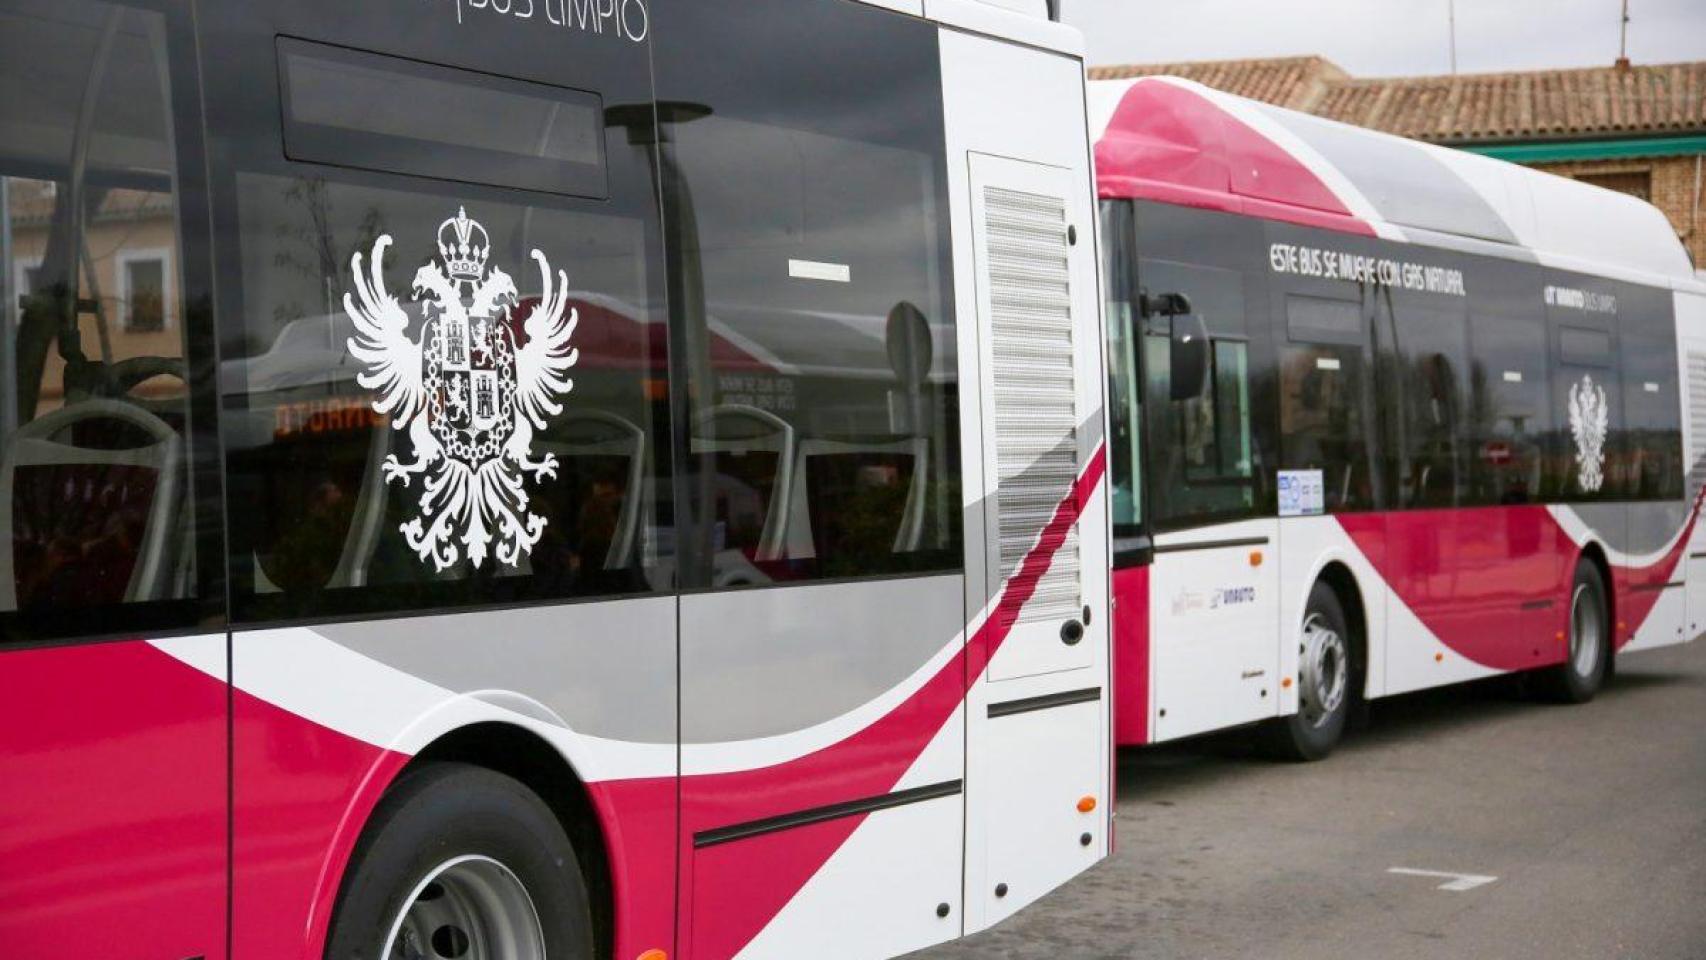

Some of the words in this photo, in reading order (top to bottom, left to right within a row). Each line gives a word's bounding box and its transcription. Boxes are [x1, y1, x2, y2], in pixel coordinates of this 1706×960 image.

[1270, 243, 1298, 273] ESTE
[1300, 246, 1322, 276] BUS
[1324, 250, 1338, 278] SE
[1339, 252, 1377, 284] MUEVE
[1378, 259, 1402, 288] CON
[1403, 262, 1424, 290] GAS
[1425, 265, 1466, 296] NATURAL
[1223, 586, 1255, 605] UNAUTO
